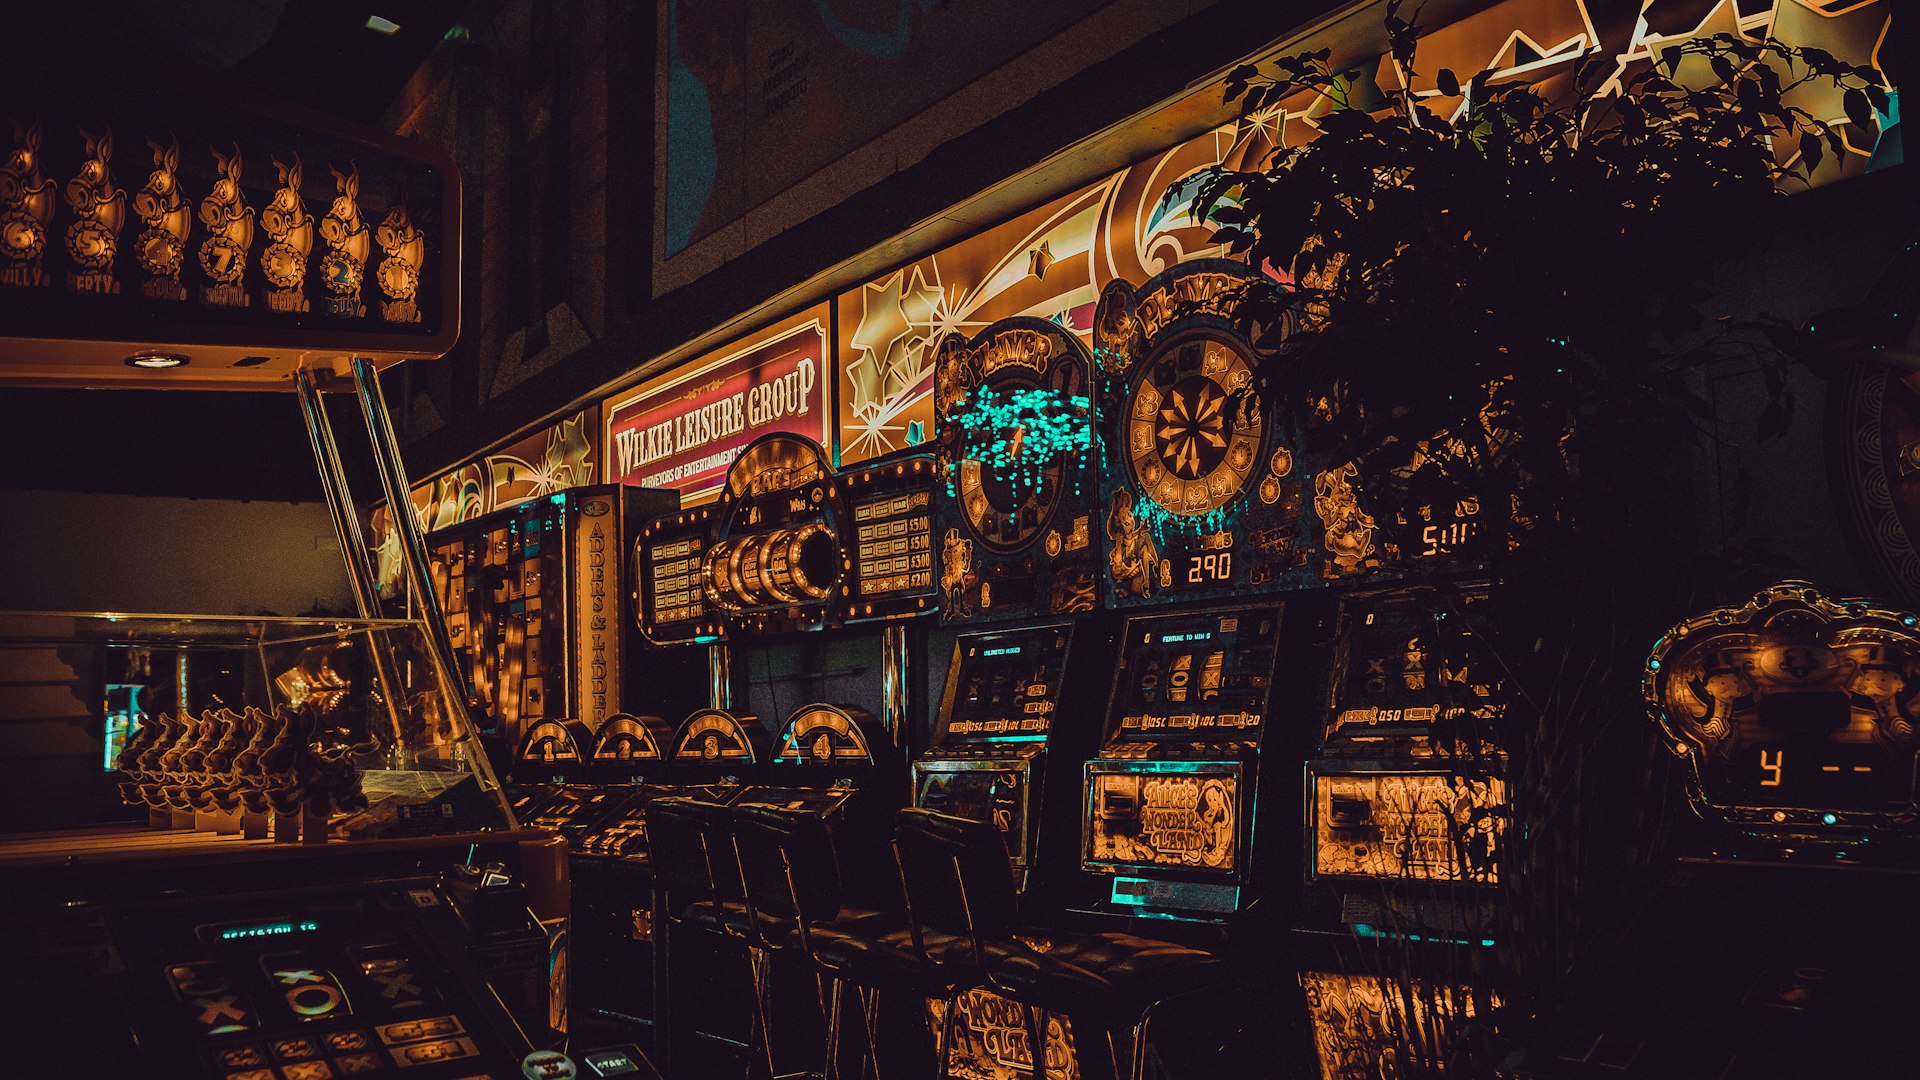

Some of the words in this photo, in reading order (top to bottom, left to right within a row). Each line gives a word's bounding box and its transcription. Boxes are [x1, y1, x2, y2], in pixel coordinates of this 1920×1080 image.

[80, 230, 101, 257] 5
[213, 244, 232, 273] 7
[331, 259, 350, 285] 2
[966, 329, 1053, 387] PLAYER
[1205, 346, 1228, 376] £1
[1136, 390, 1160, 418] £3
[615, 420, 673, 479] WILKIE
[675, 392, 744, 454] LEISURE
[748, 358, 816, 428] GROUP
[1132, 424, 1154, 453] £1
[674, 466, 684, 480] OF
[684, 448, 737, 477] ENTERTAINMENT
[1159, 478, 1181, 510] £1
[1184, 485, 1209, 513] £2
[1211, 469, 1234, 499] £1
[909, 516, 928, 531] £5.00
[910, 534, 929, 550] £5.00
[590, 521, 607, 612] ADDERS
[911, 553, 930, 569] £3.00
[911, 571, 930, 587] £2.00
[590, 613, 607, 631] &
[1366, 614, 1374, 625] 0
[591, 634, 608, 732] LADDER
[543, 741, 554, 761] 1
[618, 739, 630, 760] 2
[704, 736, 718, 759] 3
[813, 734, 830, 759] 4
[1144, 781, 1198, 809] ALICE'S
[1141, 806, 1202, 832] WONDER
[1151, 831, 1204, 862] LAND
[597, 1058, 627, 1069] START
